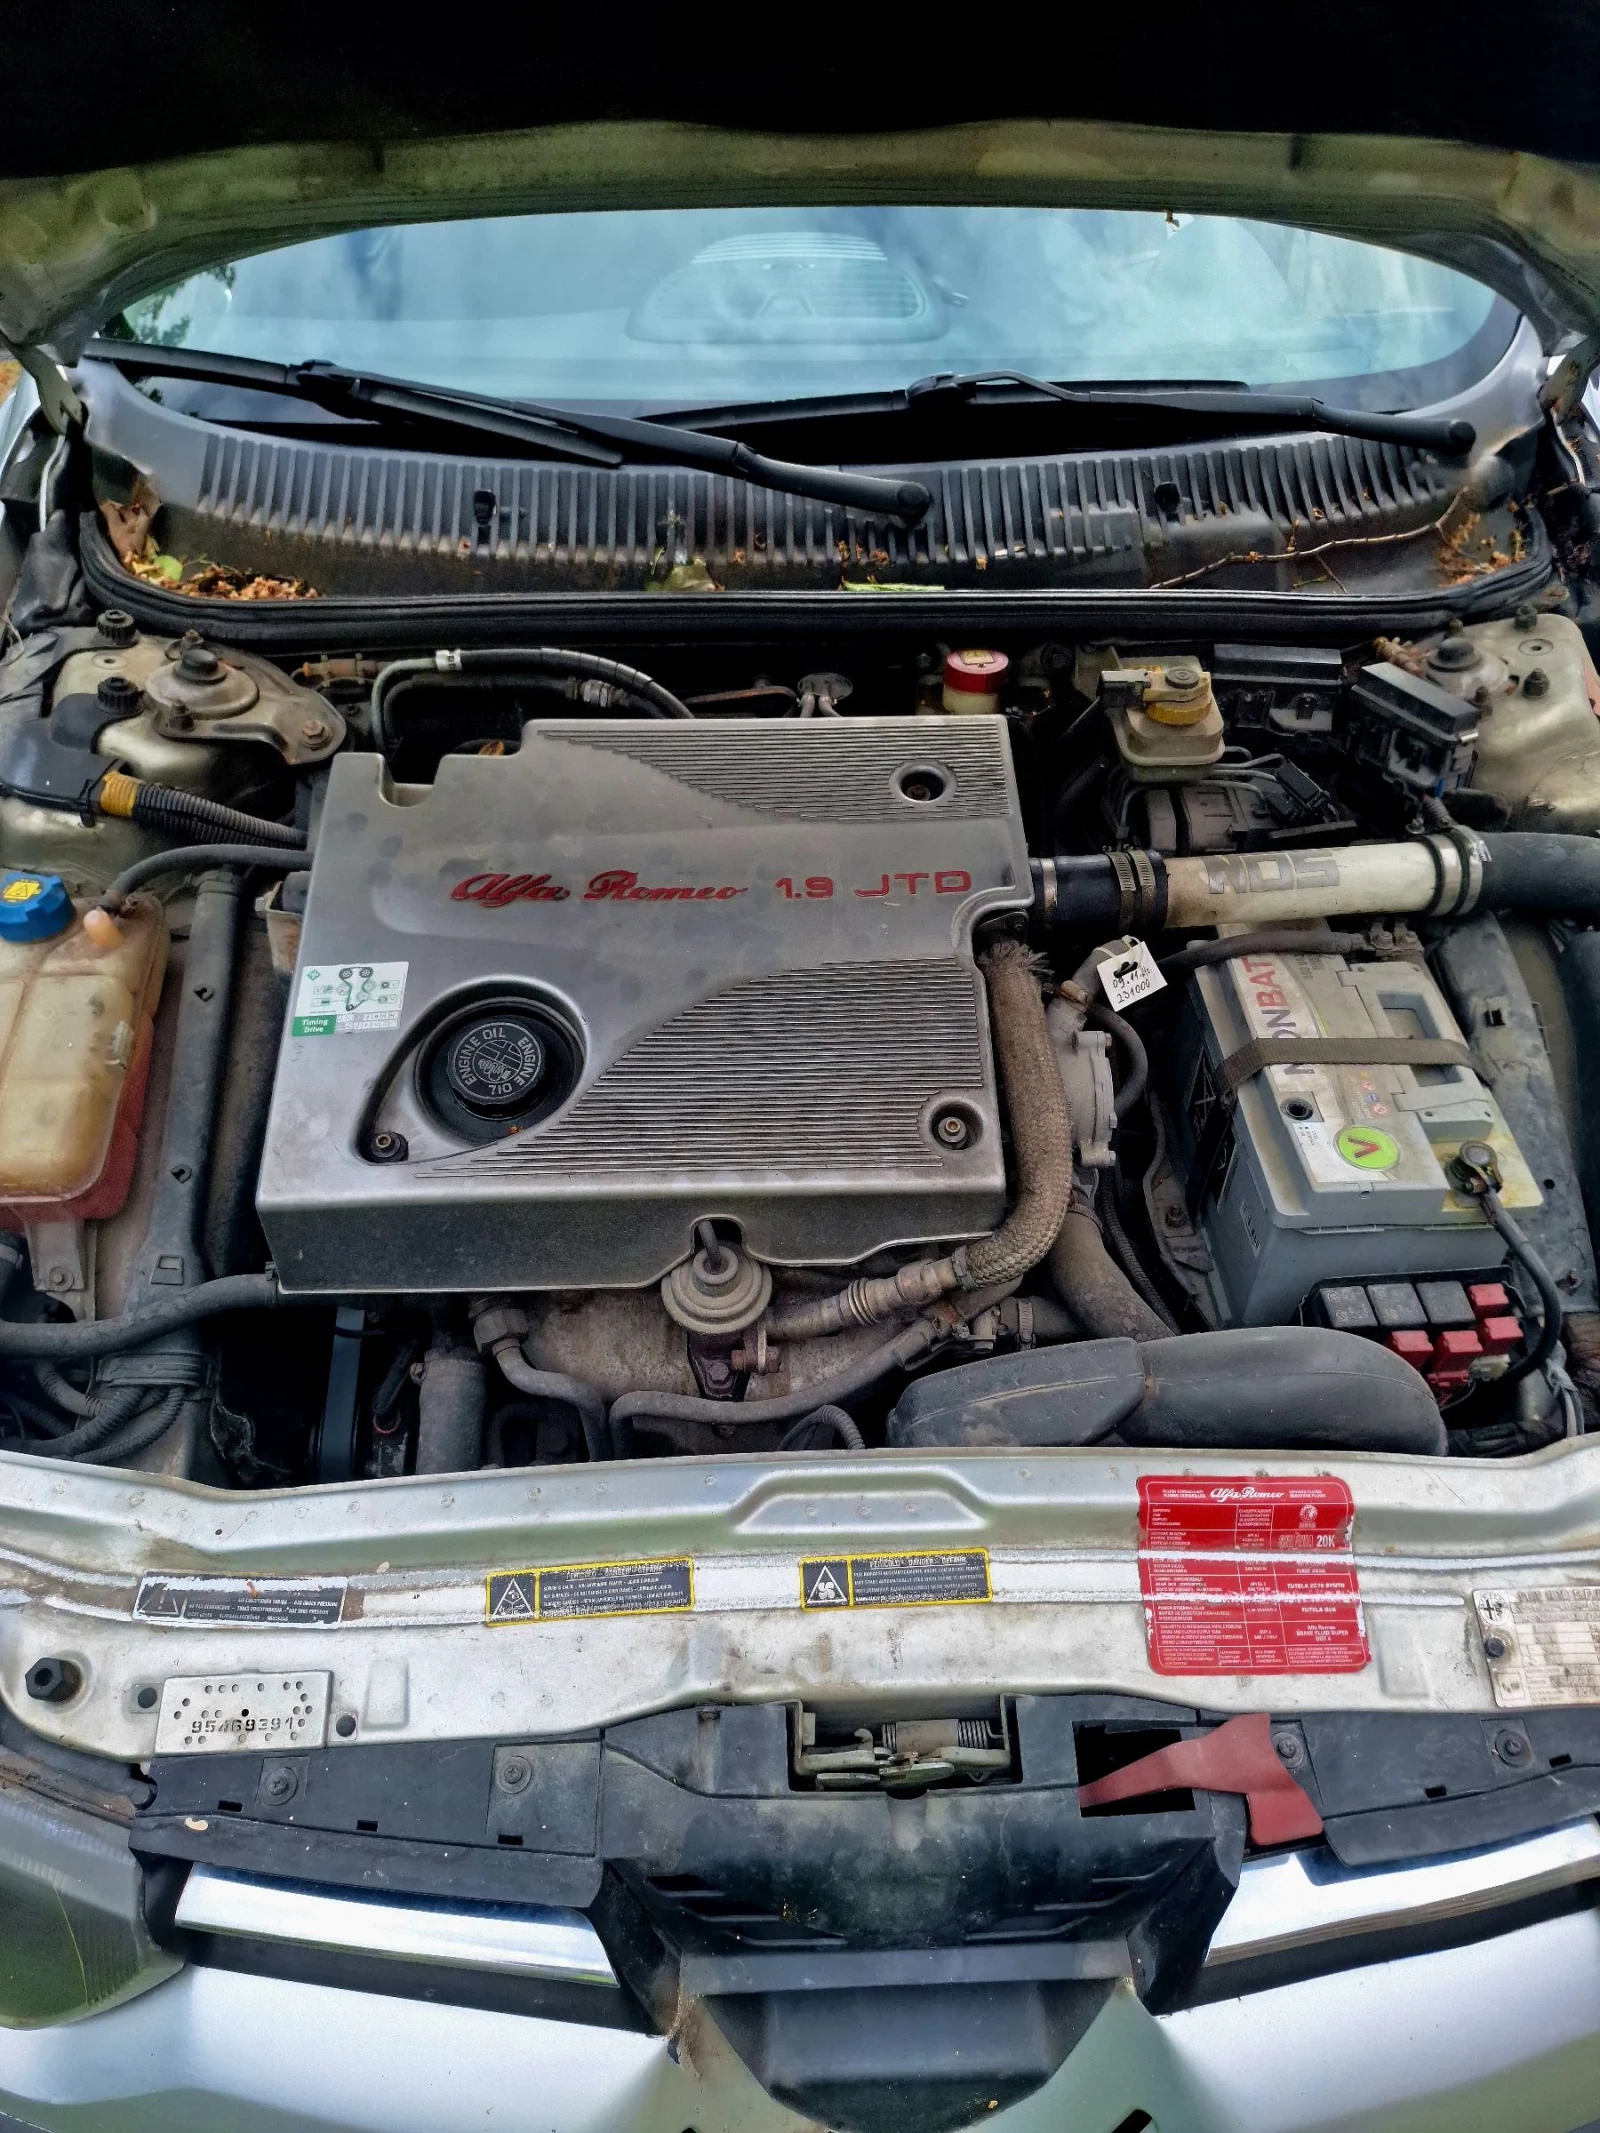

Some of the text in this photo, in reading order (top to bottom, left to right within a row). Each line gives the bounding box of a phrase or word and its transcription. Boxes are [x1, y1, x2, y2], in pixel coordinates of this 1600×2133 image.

[450, 870, 972, 908] Alfa Romeo 1.9 JTD
[1116, 978, 1151, 1004] 231000
[301, 1018, 328, 1027] Timing
[304, 1025, 324, 1033] Drive
[459, 1027, 507, 1087] ENGINE OIL
[487, 1036, 536, 1096] ENGINE OIL
[1209, 1487, 1242, 1503] Alfa
[1241, 1486, 1285, 1499] Romeo
[1316, 1534, 1336, 1548] 20K
